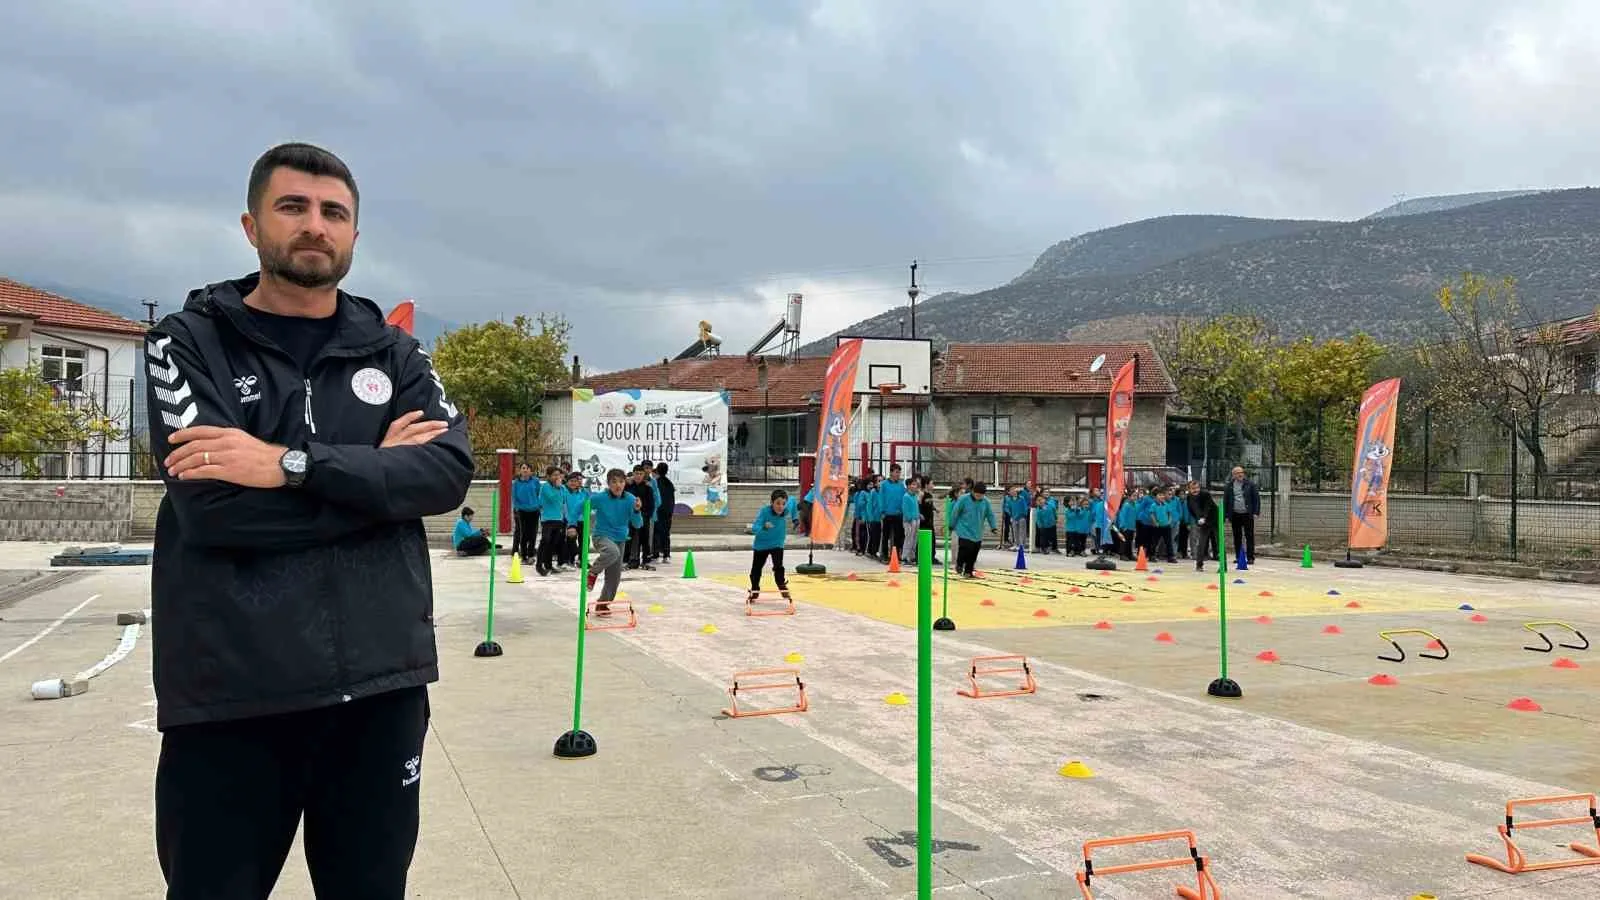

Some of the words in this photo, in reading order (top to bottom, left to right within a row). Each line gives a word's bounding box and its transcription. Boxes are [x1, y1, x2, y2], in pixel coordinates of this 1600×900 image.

[597, 422, 641, 444] ÇOCUK
[646, 420, 717, 442] ATLETİZMİ
[627, 442, 680, 464] ŞENLİĞİ
